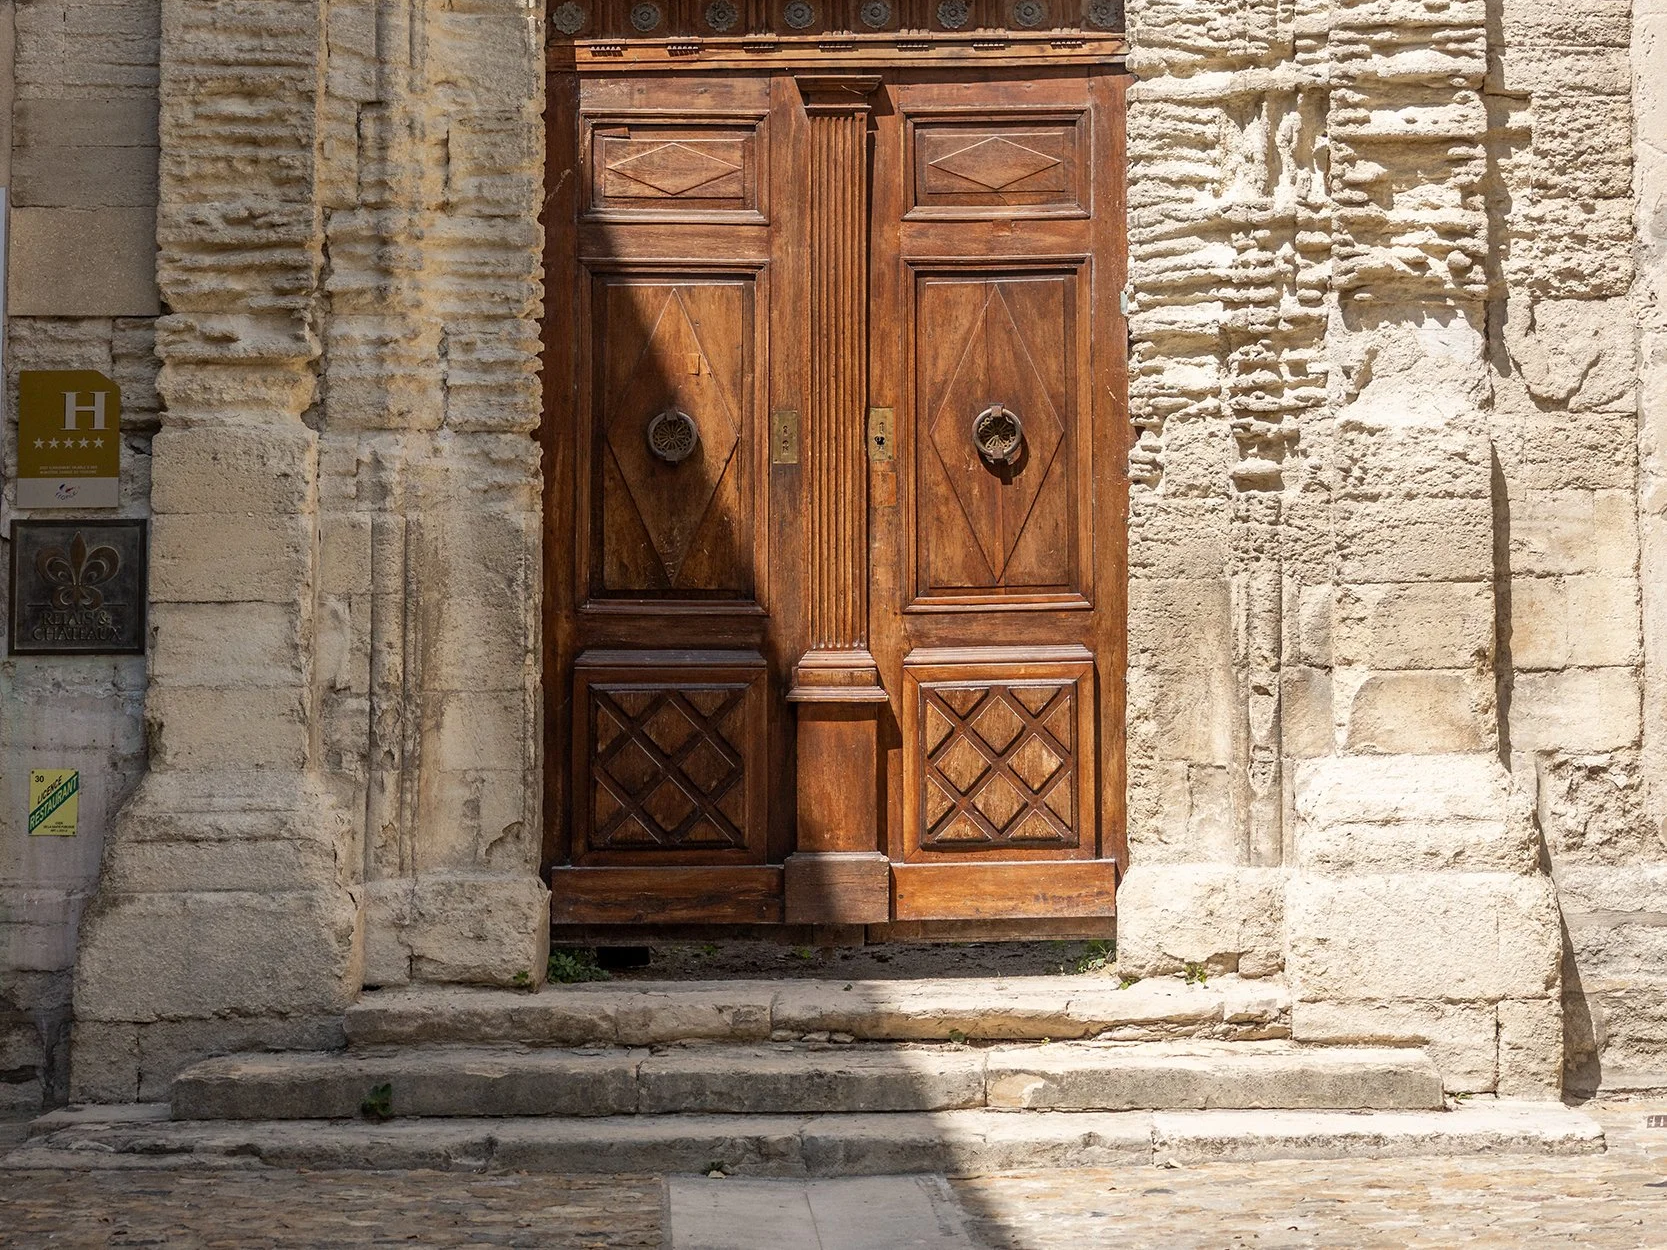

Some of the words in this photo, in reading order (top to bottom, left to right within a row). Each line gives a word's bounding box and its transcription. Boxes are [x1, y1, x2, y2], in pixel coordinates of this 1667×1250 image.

[60, 391, 110, 431] H
[42, 611, 94, 626] RELAIS
[97, 610, 112, 626] &
[34, 775, 45, 783] 30
[37, 774, 63, 805] LICENCE
[29, 774, 78, 831] RESTAURANT
